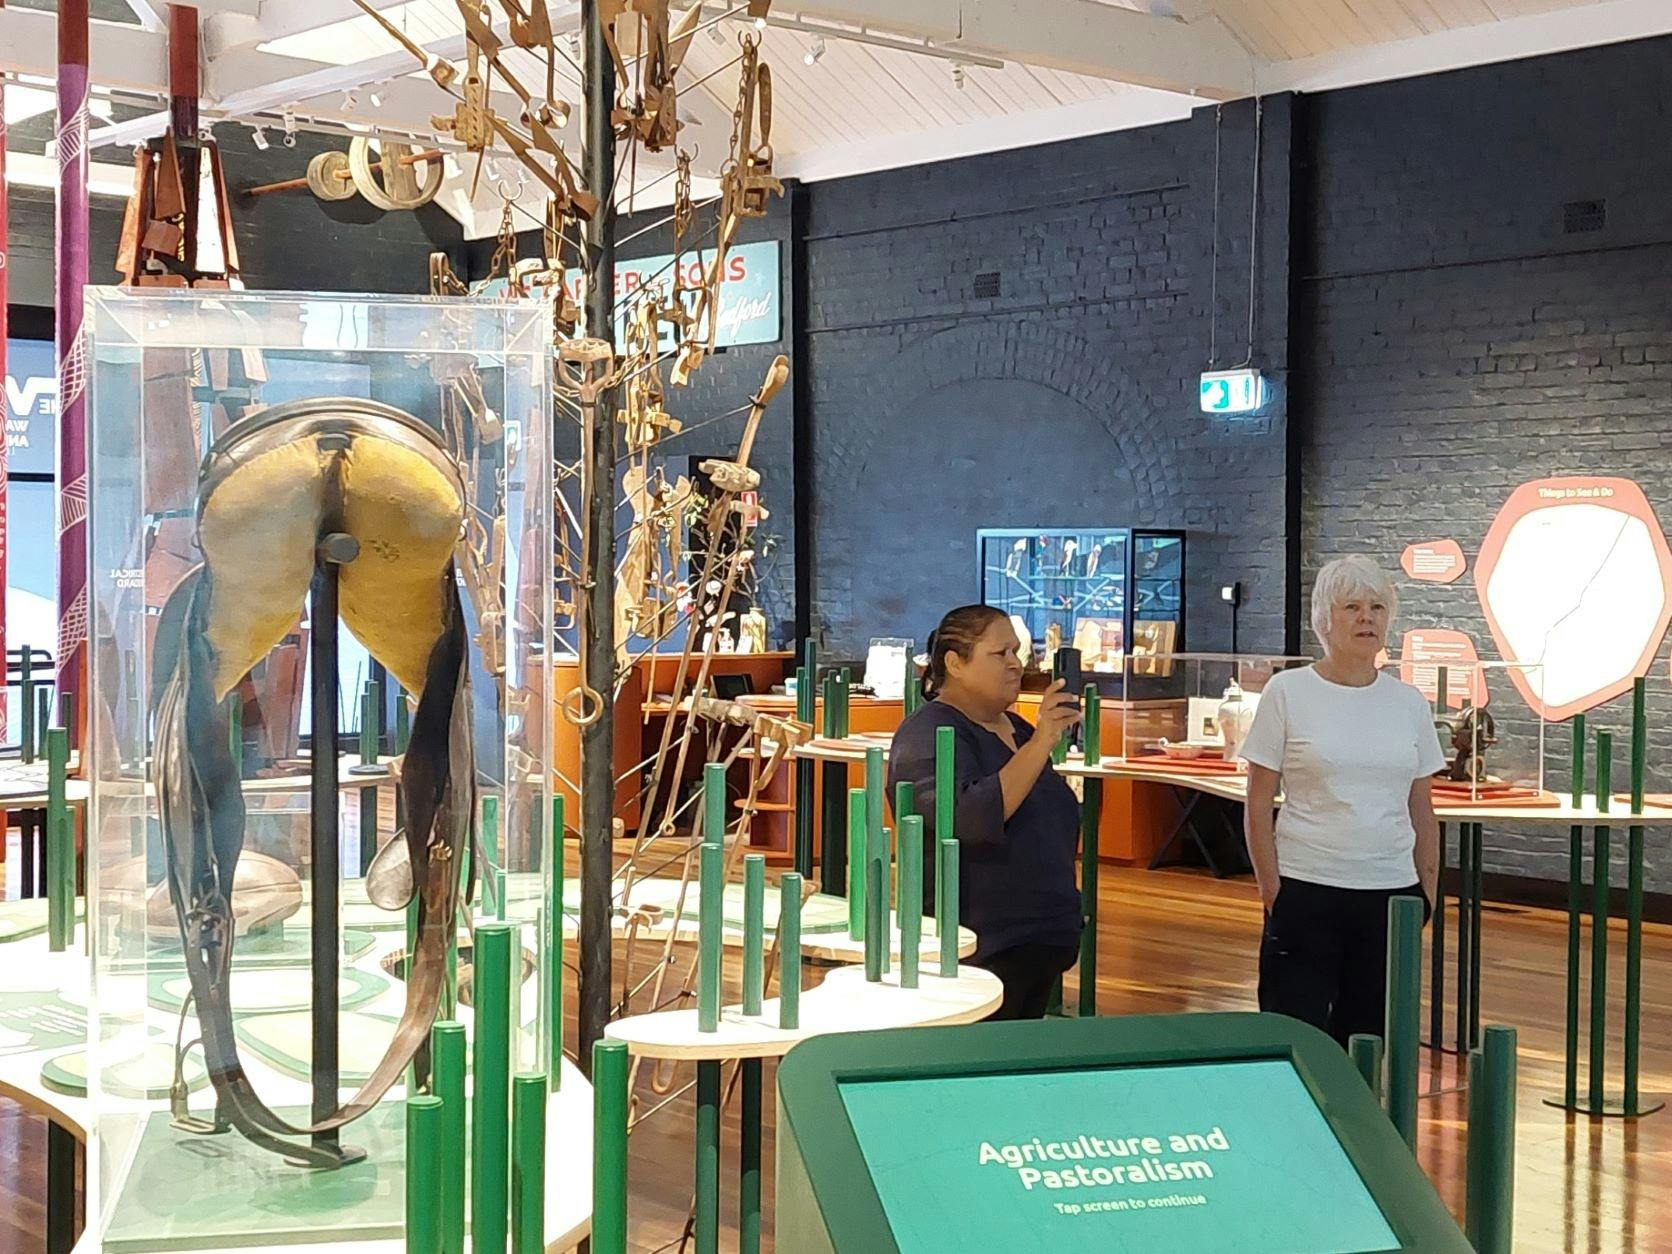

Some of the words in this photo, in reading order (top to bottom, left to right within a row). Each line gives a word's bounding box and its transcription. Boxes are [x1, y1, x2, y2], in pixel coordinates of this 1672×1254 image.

[1538, 487, 1566, 499] Things
[1566, 487, 1576, 497] to
[1577, 487, 1592, 497] See
[1601, 486, 1614, 497] Do
[979, 1135, 1162, 1168] Agriculture
[1168, 1126, 1230, 1153] and
[1018, 1158, 1214, 1190] Pastoralism
[1053, 1202, 1081, 1216] Tap
[1083, 1198, 1129, 1213] screen
[1129, 1198, 1146, 1210] to
[1147, 1193, 1207, 1209] continue
